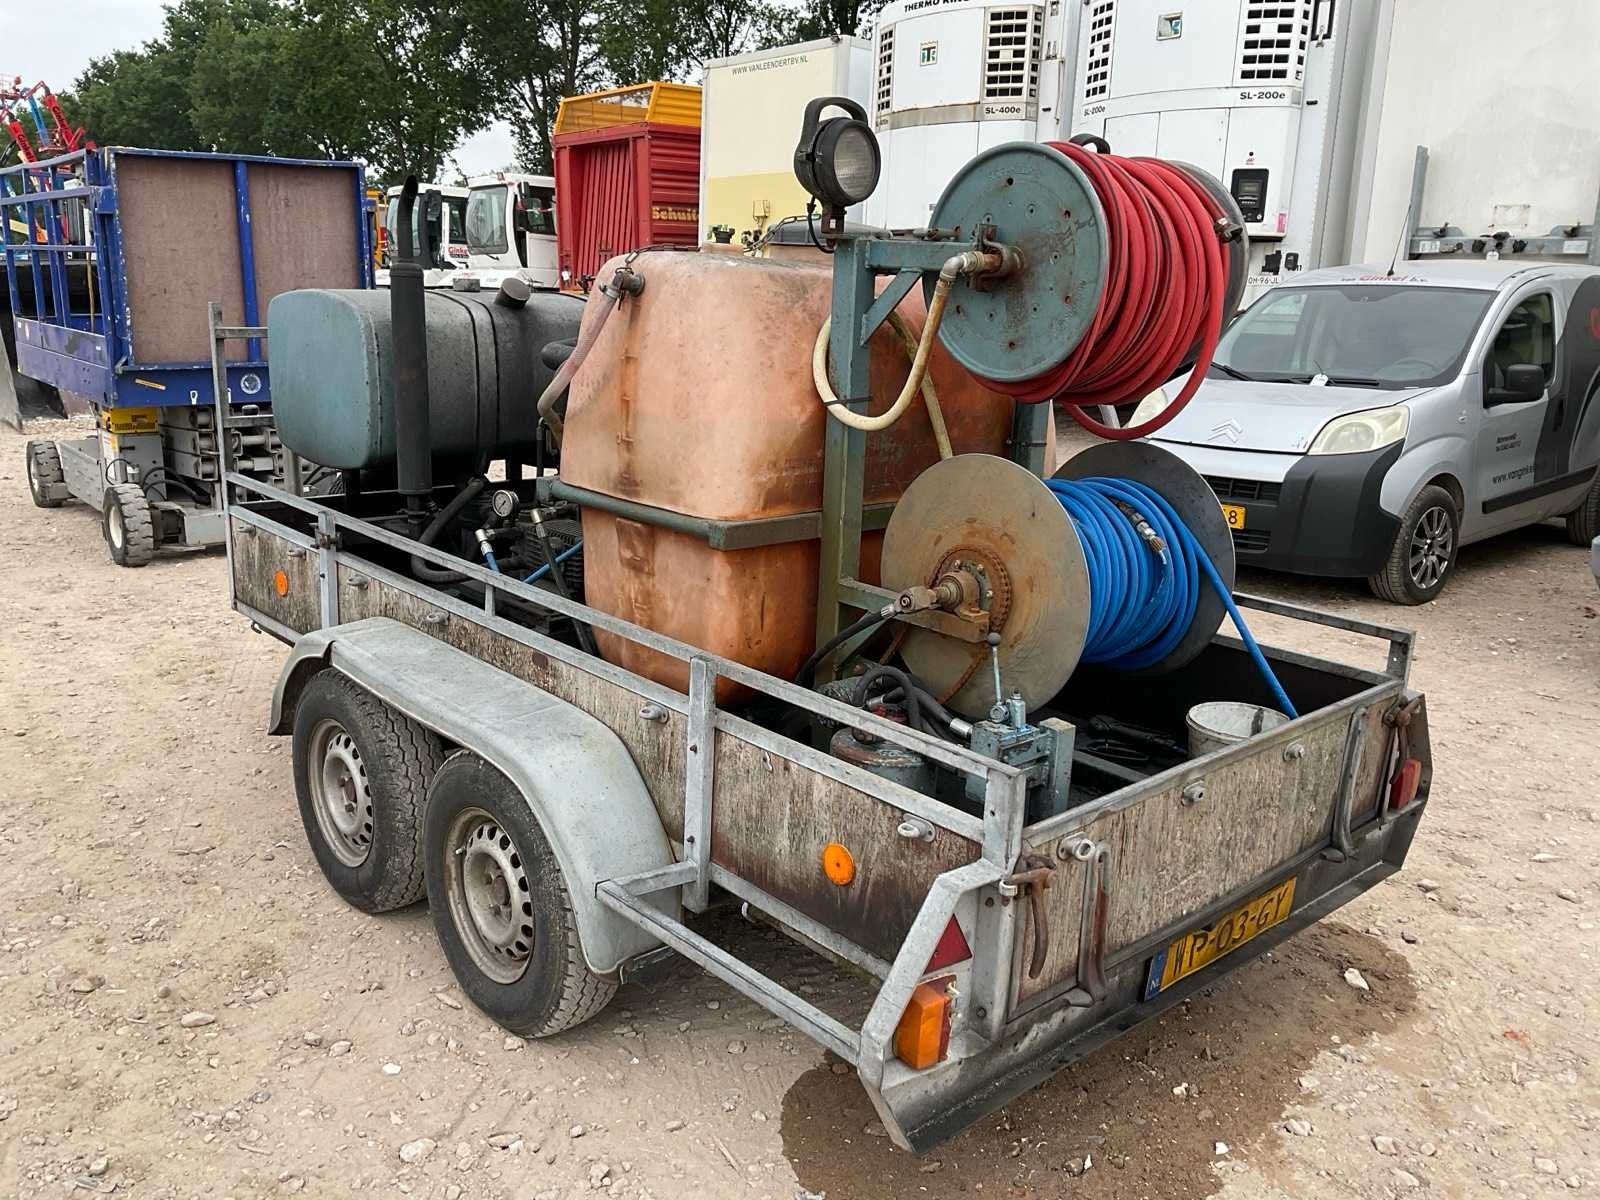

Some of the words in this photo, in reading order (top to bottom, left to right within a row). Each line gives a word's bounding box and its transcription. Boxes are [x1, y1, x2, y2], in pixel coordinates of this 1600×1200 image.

[904, 0, 940, 13] THERMO
[1240, 91, 1286, 100] SL-200e
[985, 106, 1021, 115] SL-400e
